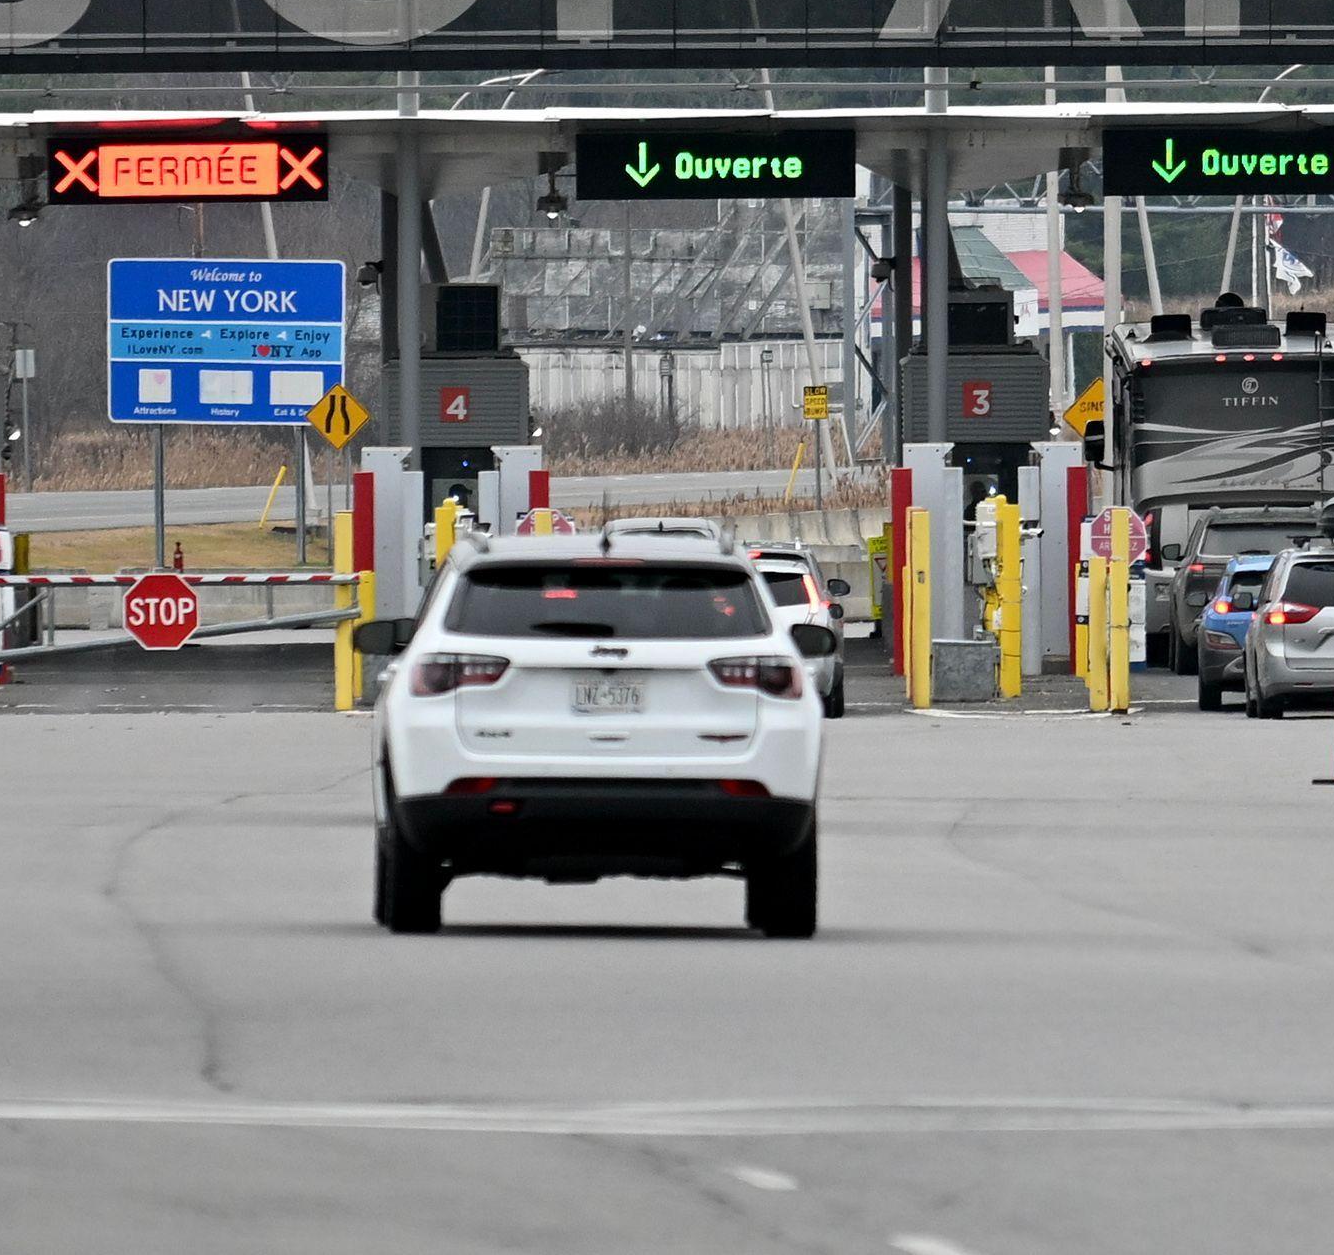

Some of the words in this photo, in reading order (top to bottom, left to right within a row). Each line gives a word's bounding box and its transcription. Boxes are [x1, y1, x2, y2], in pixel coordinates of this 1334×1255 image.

[114, 147, 259, 186] FERMÉE
[675, 151, 803, 180] Ouverte
[1201, 148, 1329, 176] Ouverte
[190, 267, 245, 283] Welcome
[249, 270, 262, 283] to
[157, 288, 216, 312] NEW
[223, 289, 298, 313] YORK
[121, 328, 194, 340] Experience
[220, 328, 270, 341] Explore
[295, 329, 331, 343] Enjoy
[301, 348, 322, 359] App
[446, 394, 467, 420] 4
[971, 389, 990, 415] 3
[1222, 395, 1279, 406] TIFFIN
[128, 597, 195, 626] STOP
